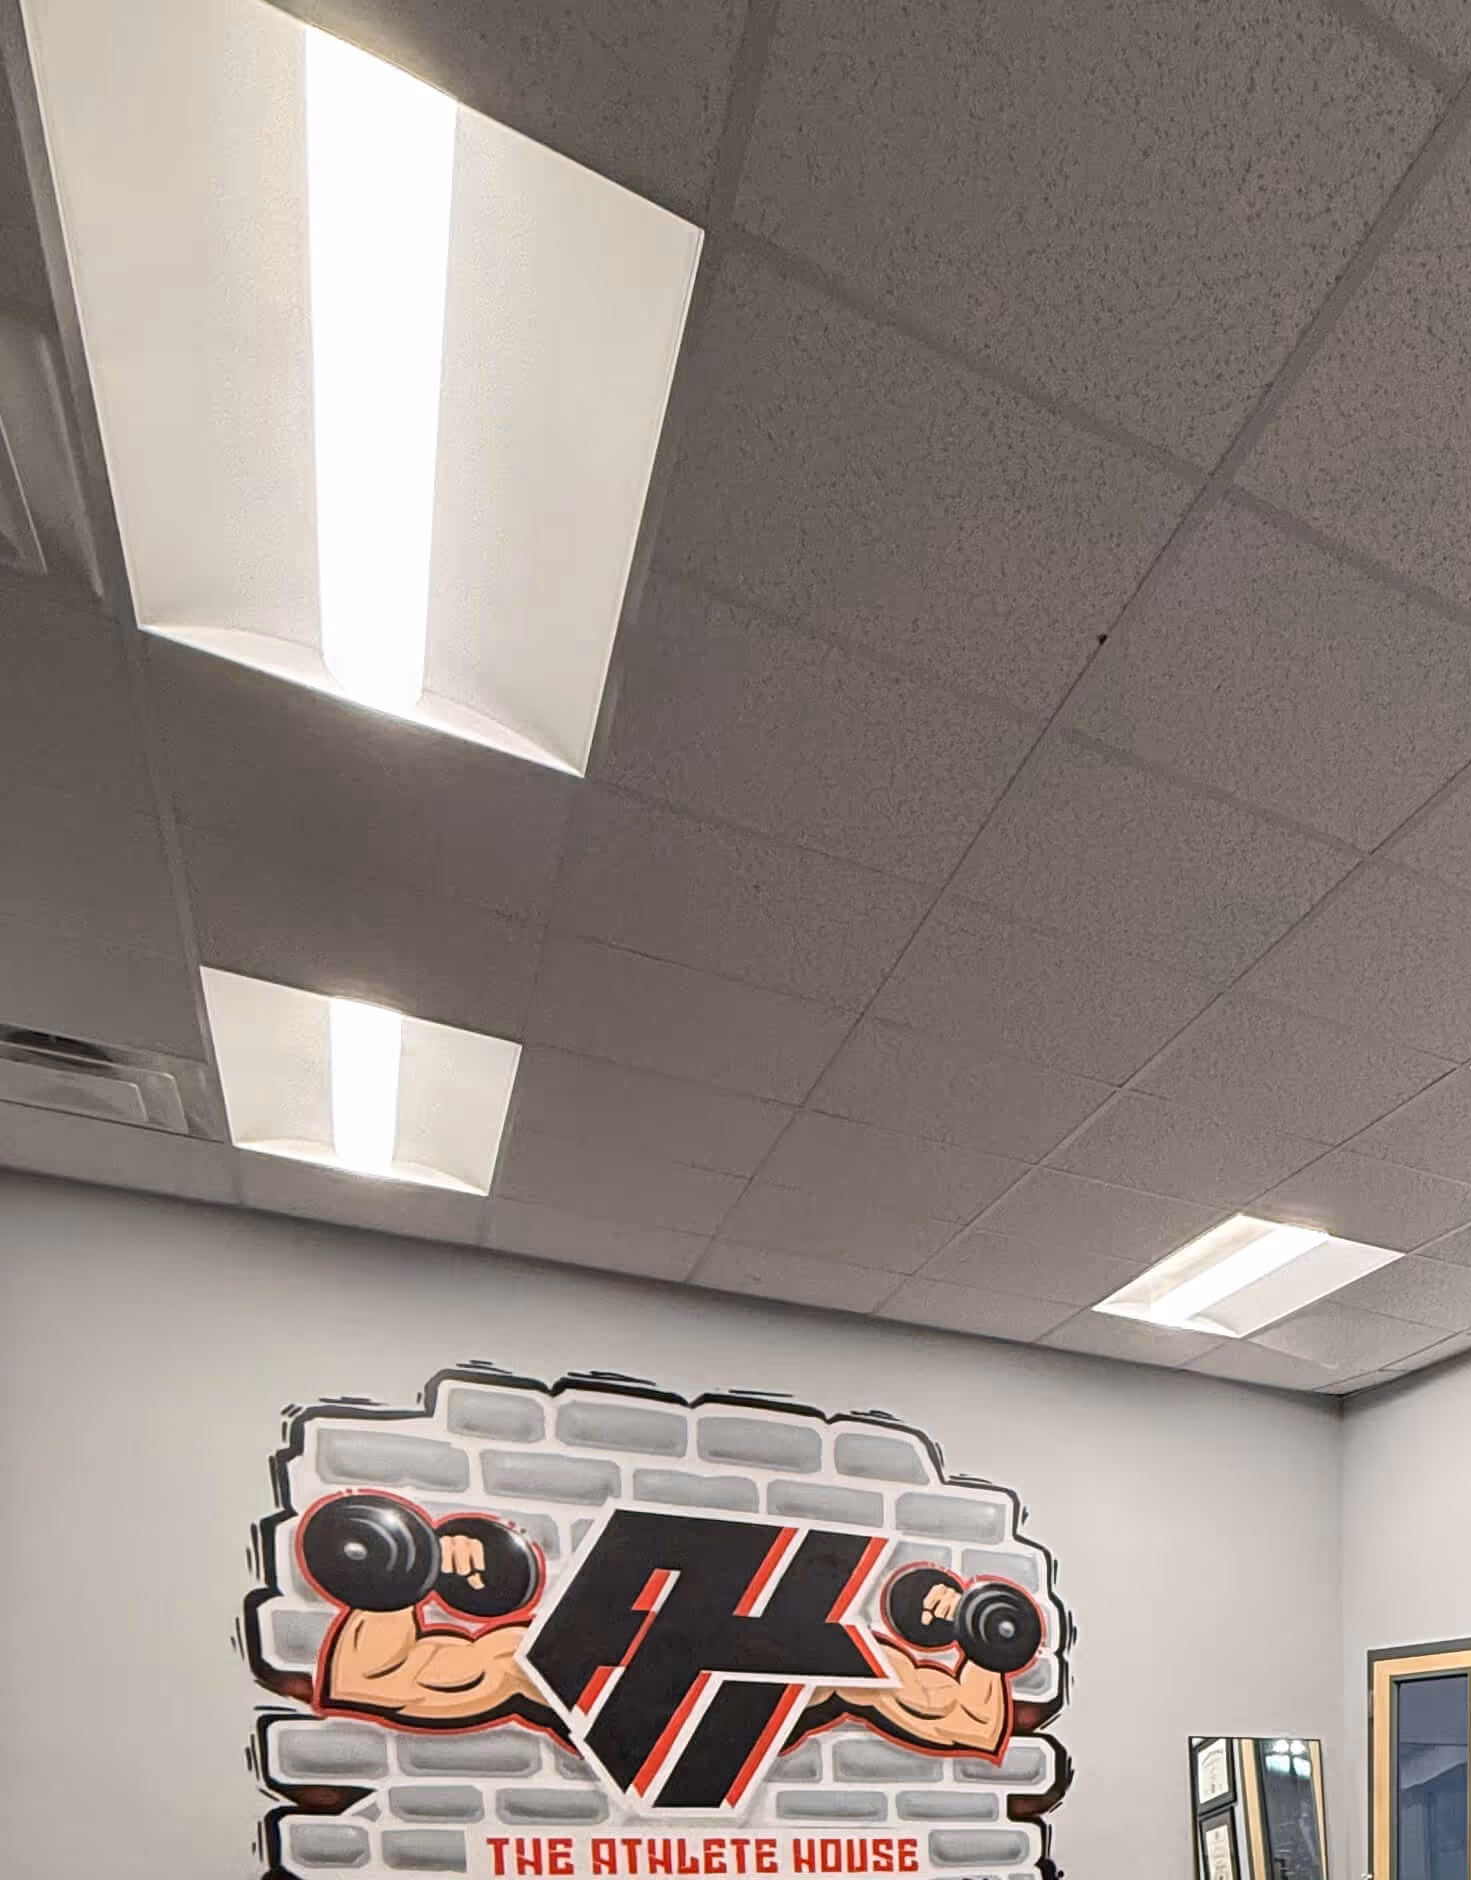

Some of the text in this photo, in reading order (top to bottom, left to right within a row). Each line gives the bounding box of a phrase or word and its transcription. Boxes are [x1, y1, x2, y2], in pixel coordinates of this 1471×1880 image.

[486, 1837, 919, 1876] THE ATHLETE HOUSE
